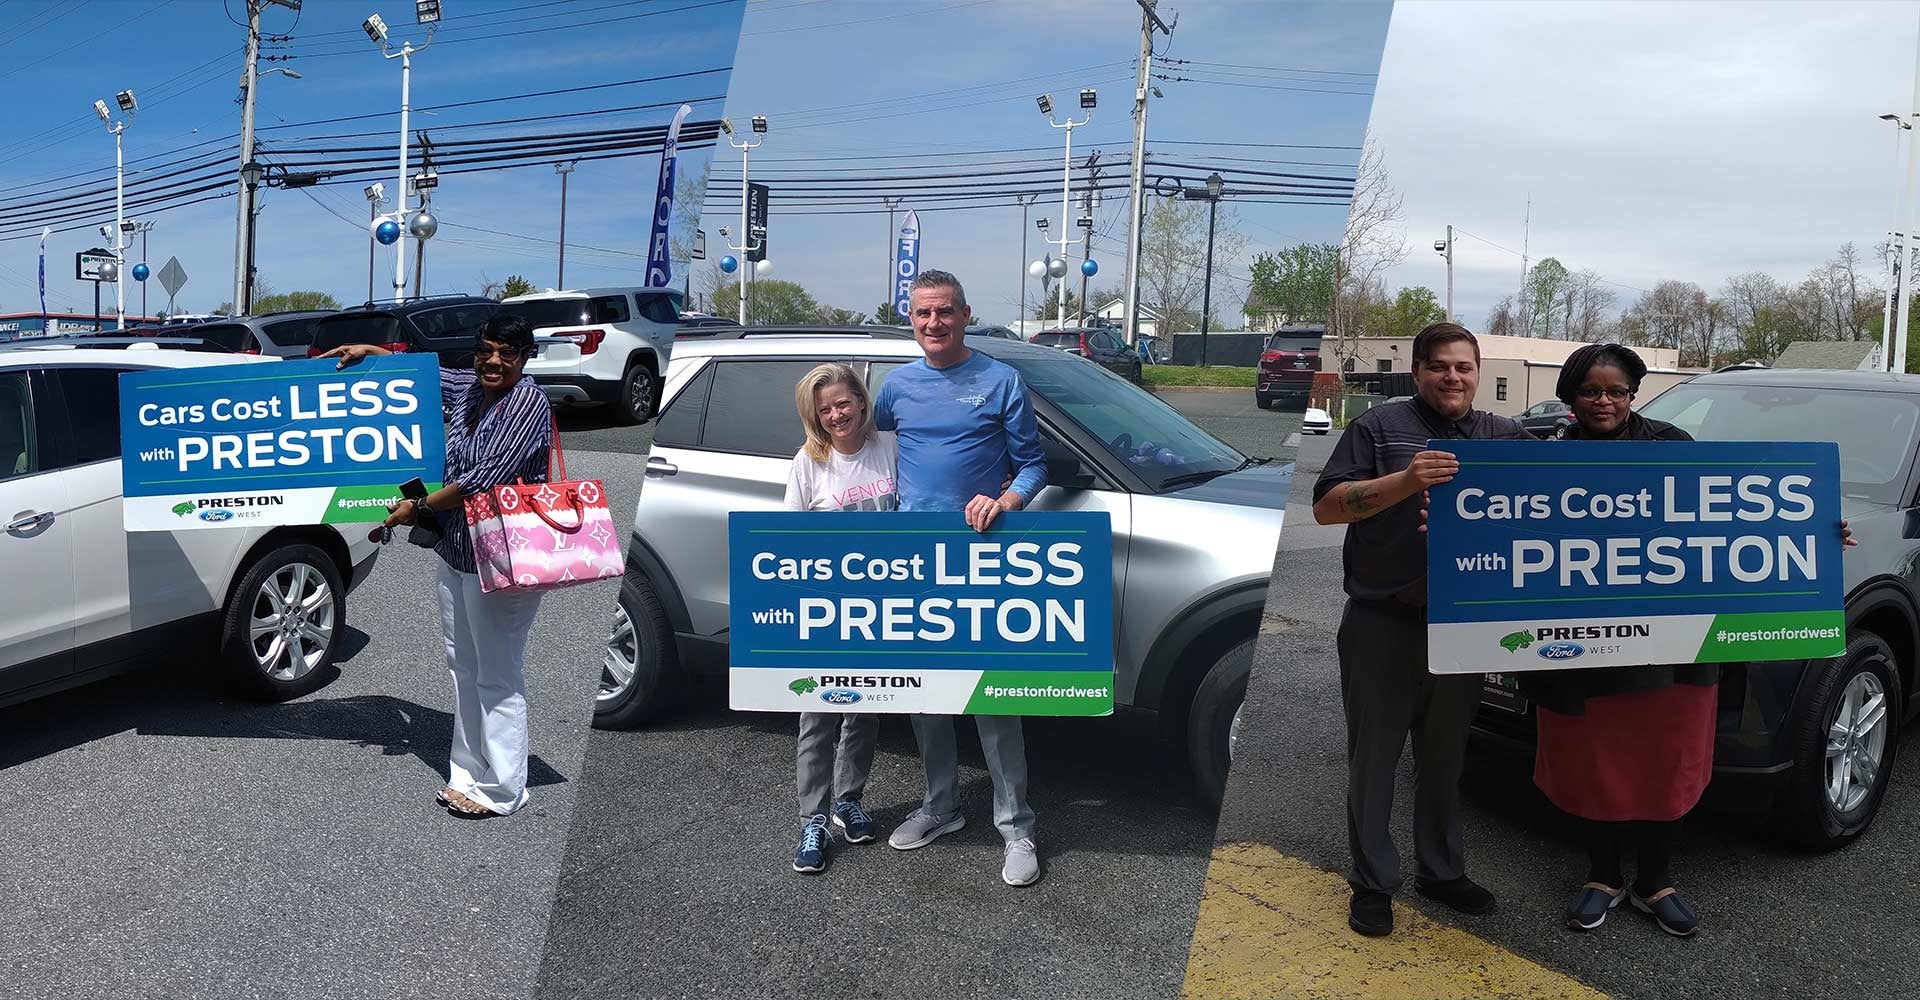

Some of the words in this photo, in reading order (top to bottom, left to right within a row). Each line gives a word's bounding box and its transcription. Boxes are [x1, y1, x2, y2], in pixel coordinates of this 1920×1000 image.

[138, 403, 205, 427] Cars
[211, 395, 282, 422] Cost
[289, 378, 418, 420] LESS
[139, 447, 175, 463] with
[177, 424, 423, 472] PRESTON
[832, 477, 897, 506] VENICE
[1456, 487, 1552, 520] Cars
[1560, 487, 1652, 519] Cost
[1664, 474, 1815, 522] LESS
[198, 495, 283, 508] PRESTON
[337, 495, 403, 510] #prestonf
[752, 552, 833, 581] Cars
[840, 552, 925, 581] Cost
[935, 542, 1084, 586] LESS
[1455, 552, 1506, 571] with
[1512, 534, 1818, 588] PRESTON
[752, 608, 795, 625] with
[799, 597, 1085, 643] PRESTON
[1537, 624, 1650, 641] PRESTON
[1716, 626, 1841, 644] #prestonfordwest
[1590, 645, 1621, 655] WEST
[820, 675, 922, 688] PRESTON
[866, 694, 895, 702] WEST
[983, 685, 1108, 699] #prestonfordwest
